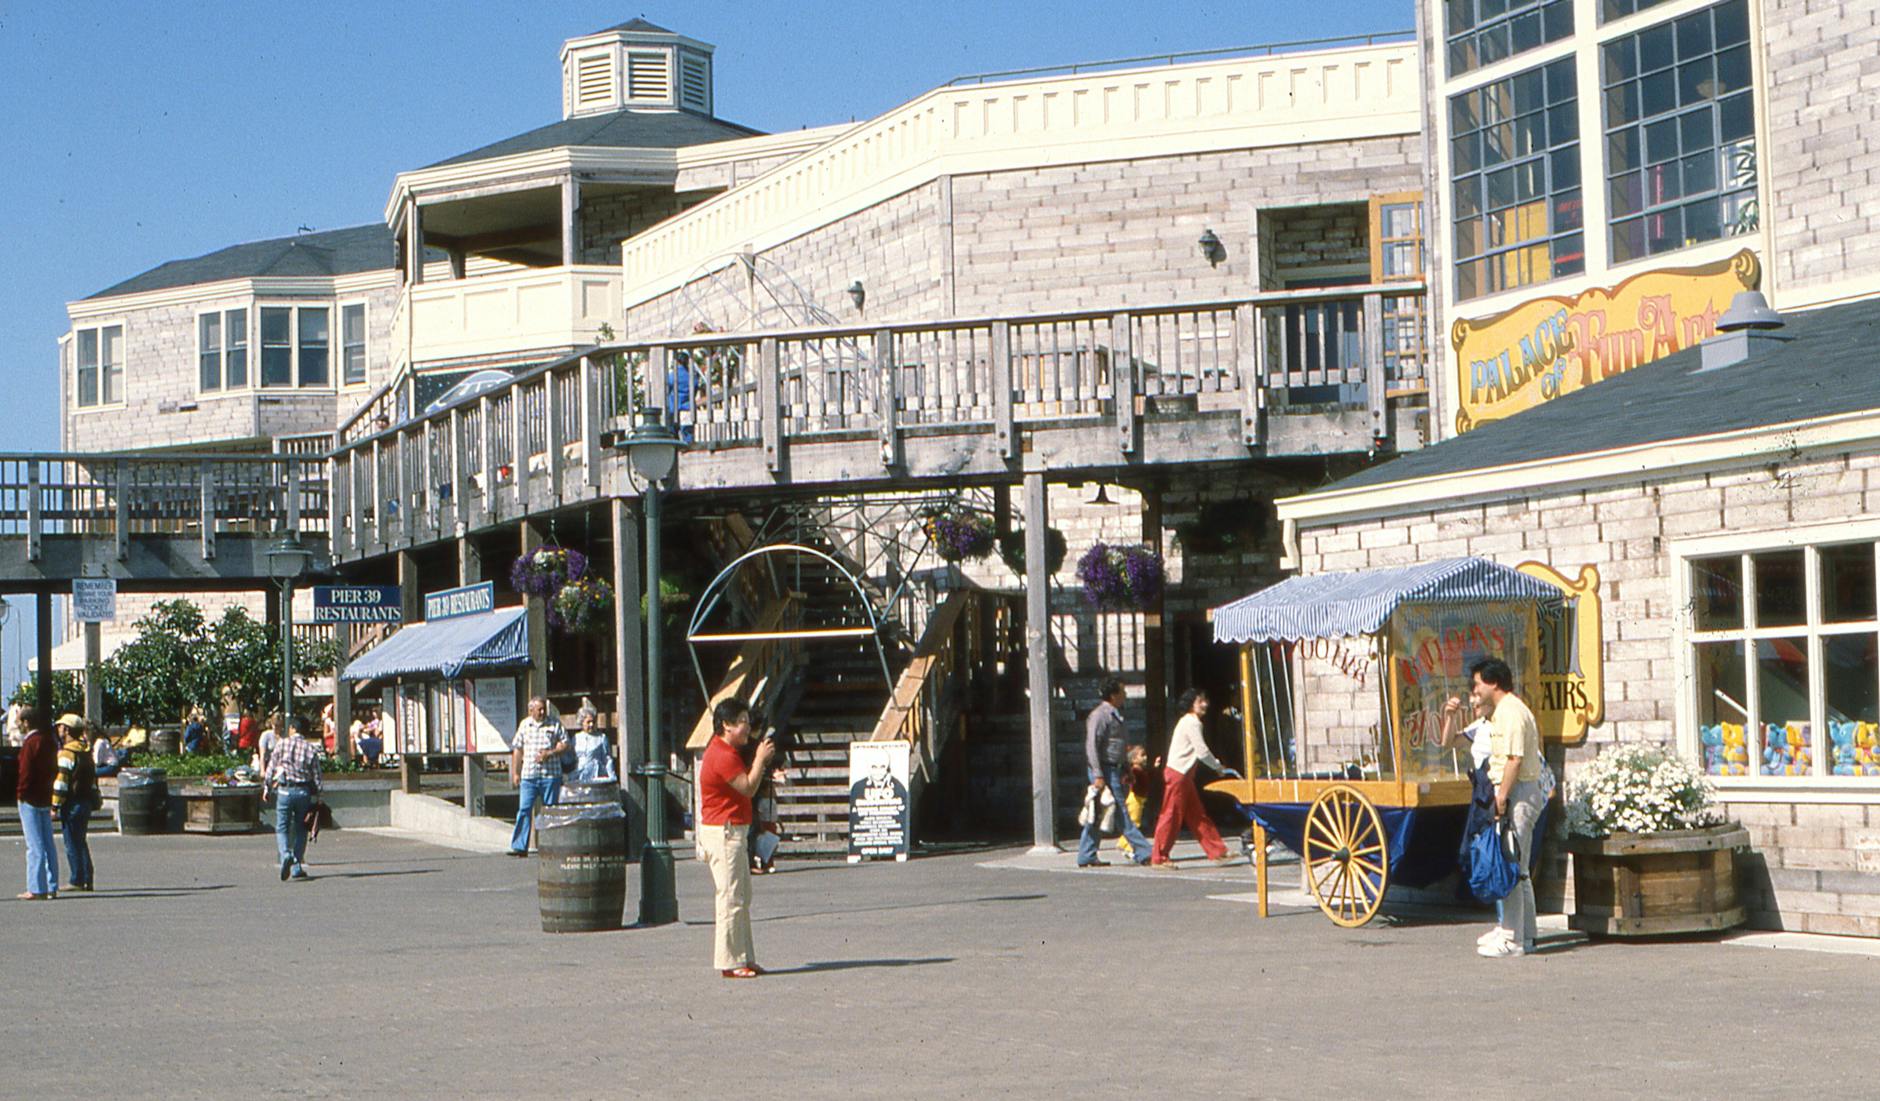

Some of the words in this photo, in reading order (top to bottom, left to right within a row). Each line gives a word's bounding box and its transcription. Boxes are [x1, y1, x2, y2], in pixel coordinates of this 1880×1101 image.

[1470, 308, 1575, 404] PALACE
[1567, 308, 1645, 386] Fun
[1541, 356, 1566, 400] of
[76, 581, 113, 590] REMEMBER
[331, 589, 362, 604] PIER
[364, 589, 382, 604] 39
[316, 606, 400, 621] RESTAURANTS
[427, 598, 440, 619] PIER
[440, 595, 449, 617] 39
[450, 588, 489, 615] RESTAURANTS
[864, 787, 894, 801] UFO
